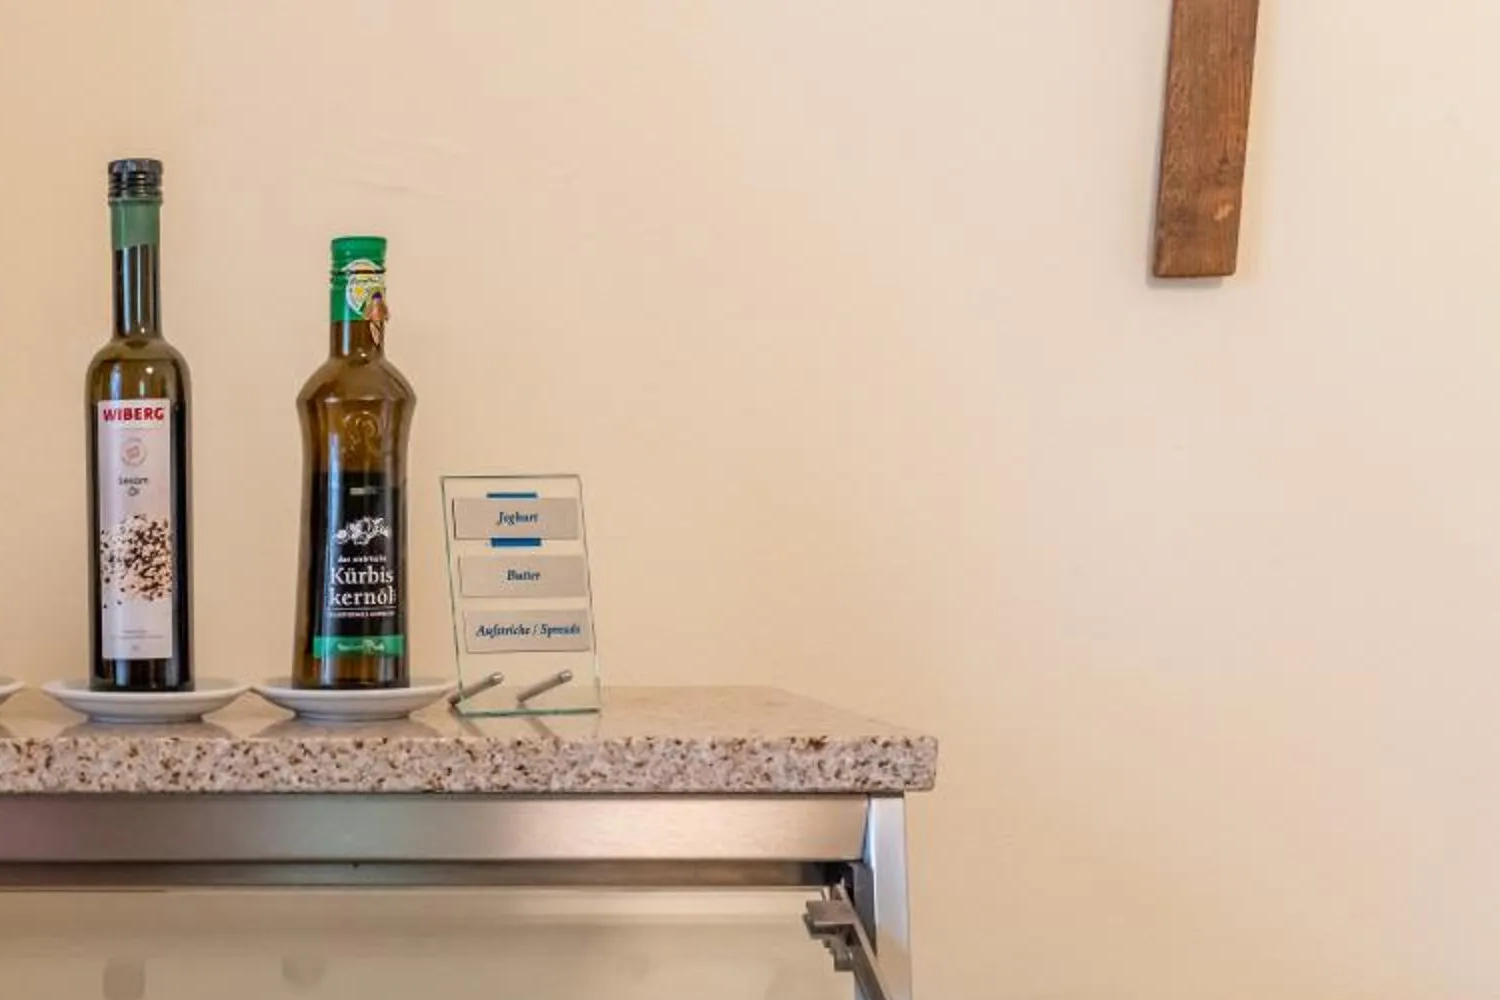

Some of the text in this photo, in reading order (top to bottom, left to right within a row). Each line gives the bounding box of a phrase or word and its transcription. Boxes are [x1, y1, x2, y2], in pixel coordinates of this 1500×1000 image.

[103, 407, 165, 422] WIBERG
[495, 511, 538, 526] Joghurt
[329, 565, 394, 585] Kürbis
[506, 569, 540, 581] Butter
[328, 585, 394, 606] kernöl
[475, 623, 530, 639] Aufstriche
